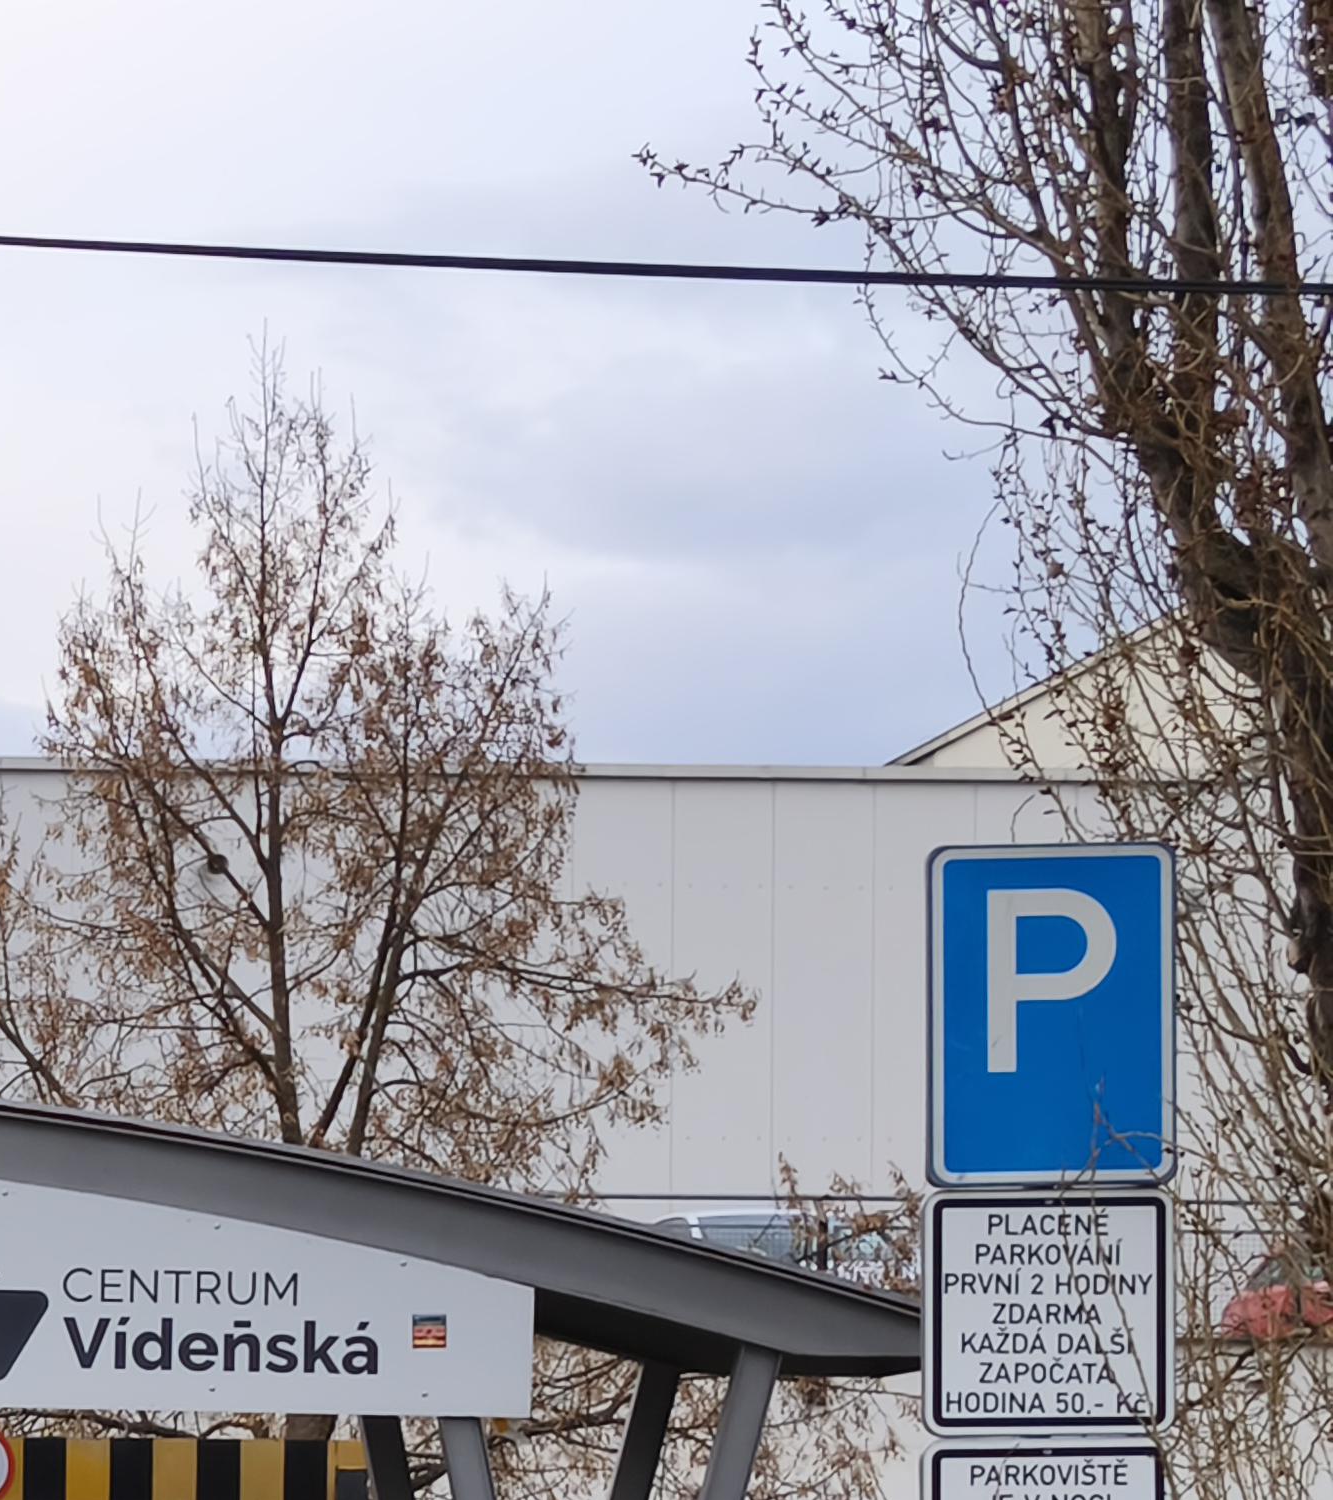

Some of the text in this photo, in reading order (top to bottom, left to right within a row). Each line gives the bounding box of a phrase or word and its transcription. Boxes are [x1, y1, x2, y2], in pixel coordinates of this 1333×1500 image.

[987, 888, 1117, 1073] P
[988, 1209, 1109, 1236] PLACENÉ
[975, 1239, 1123, 1265] PARKOVÁNÍ
[62, 1268, 300, 1306] CENTRUM
[944, 1268, 1152, 1295] PRVNÍ 2 HODINY
[993, 1303, 1101, 1324] ZDARMA
[961, 1327, 1134, 1355] KAŽDÁ DALŠÍ
[946, 1392, 1045, 1414] HODINA
[1117, 1392, 1147, 1415] Kč
[970, 1459, 1128, 1486] PARKOVIŠTĚ
